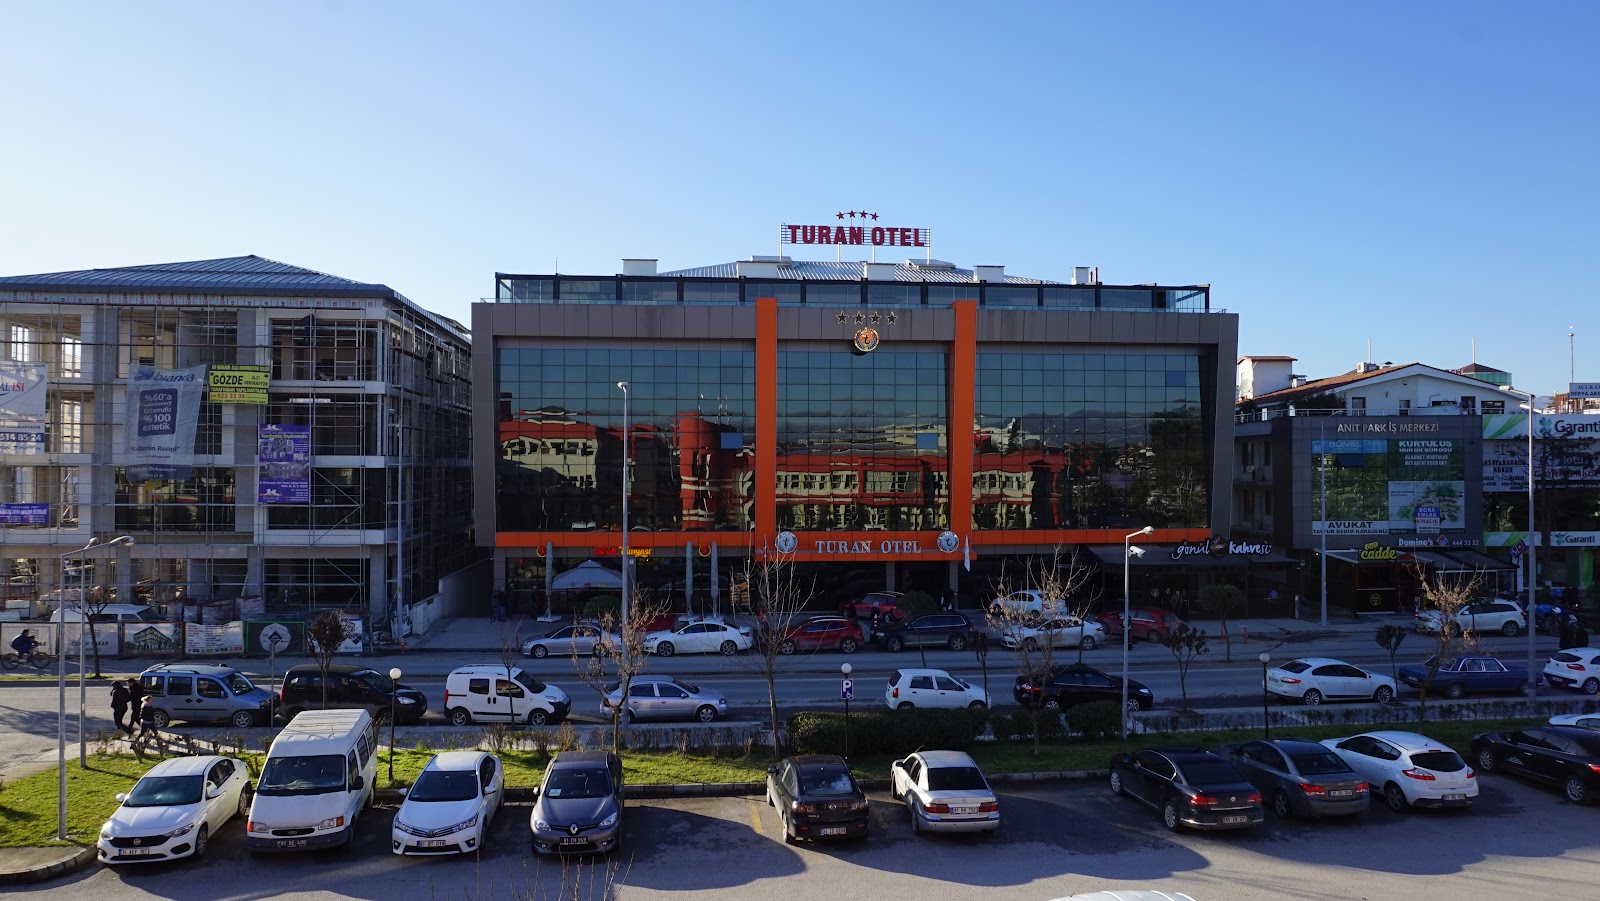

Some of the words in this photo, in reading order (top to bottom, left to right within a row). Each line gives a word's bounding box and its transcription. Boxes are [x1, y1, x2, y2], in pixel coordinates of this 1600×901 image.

[788, 225, 862, 245] TURAN
[871, 227, 925, 246] OTEL
[213, 373, 244, 385] GÖZDE
[143, 413, 171, 423] %100
[142, 422, 171, 431] estetik
[1337, 424, 1360, 433] ANIT
[1362, 424, 1387, 433] PARK
[1388, 421, 1397, 434] İŞ
[1399, 422, 1440, 432] MERKEZİ
[1555, 420, 1600, 433] Garanti
[1398, 537, 1433, 546] Domino's
[1565, 535, 1595, 543] Garanti
[815, 540, 871, 553] TURAN
[881, 540, 922, 553] OTEL
[1229, 540, 1271, 554] kahvesi
[843, 681, 852, 692] P
